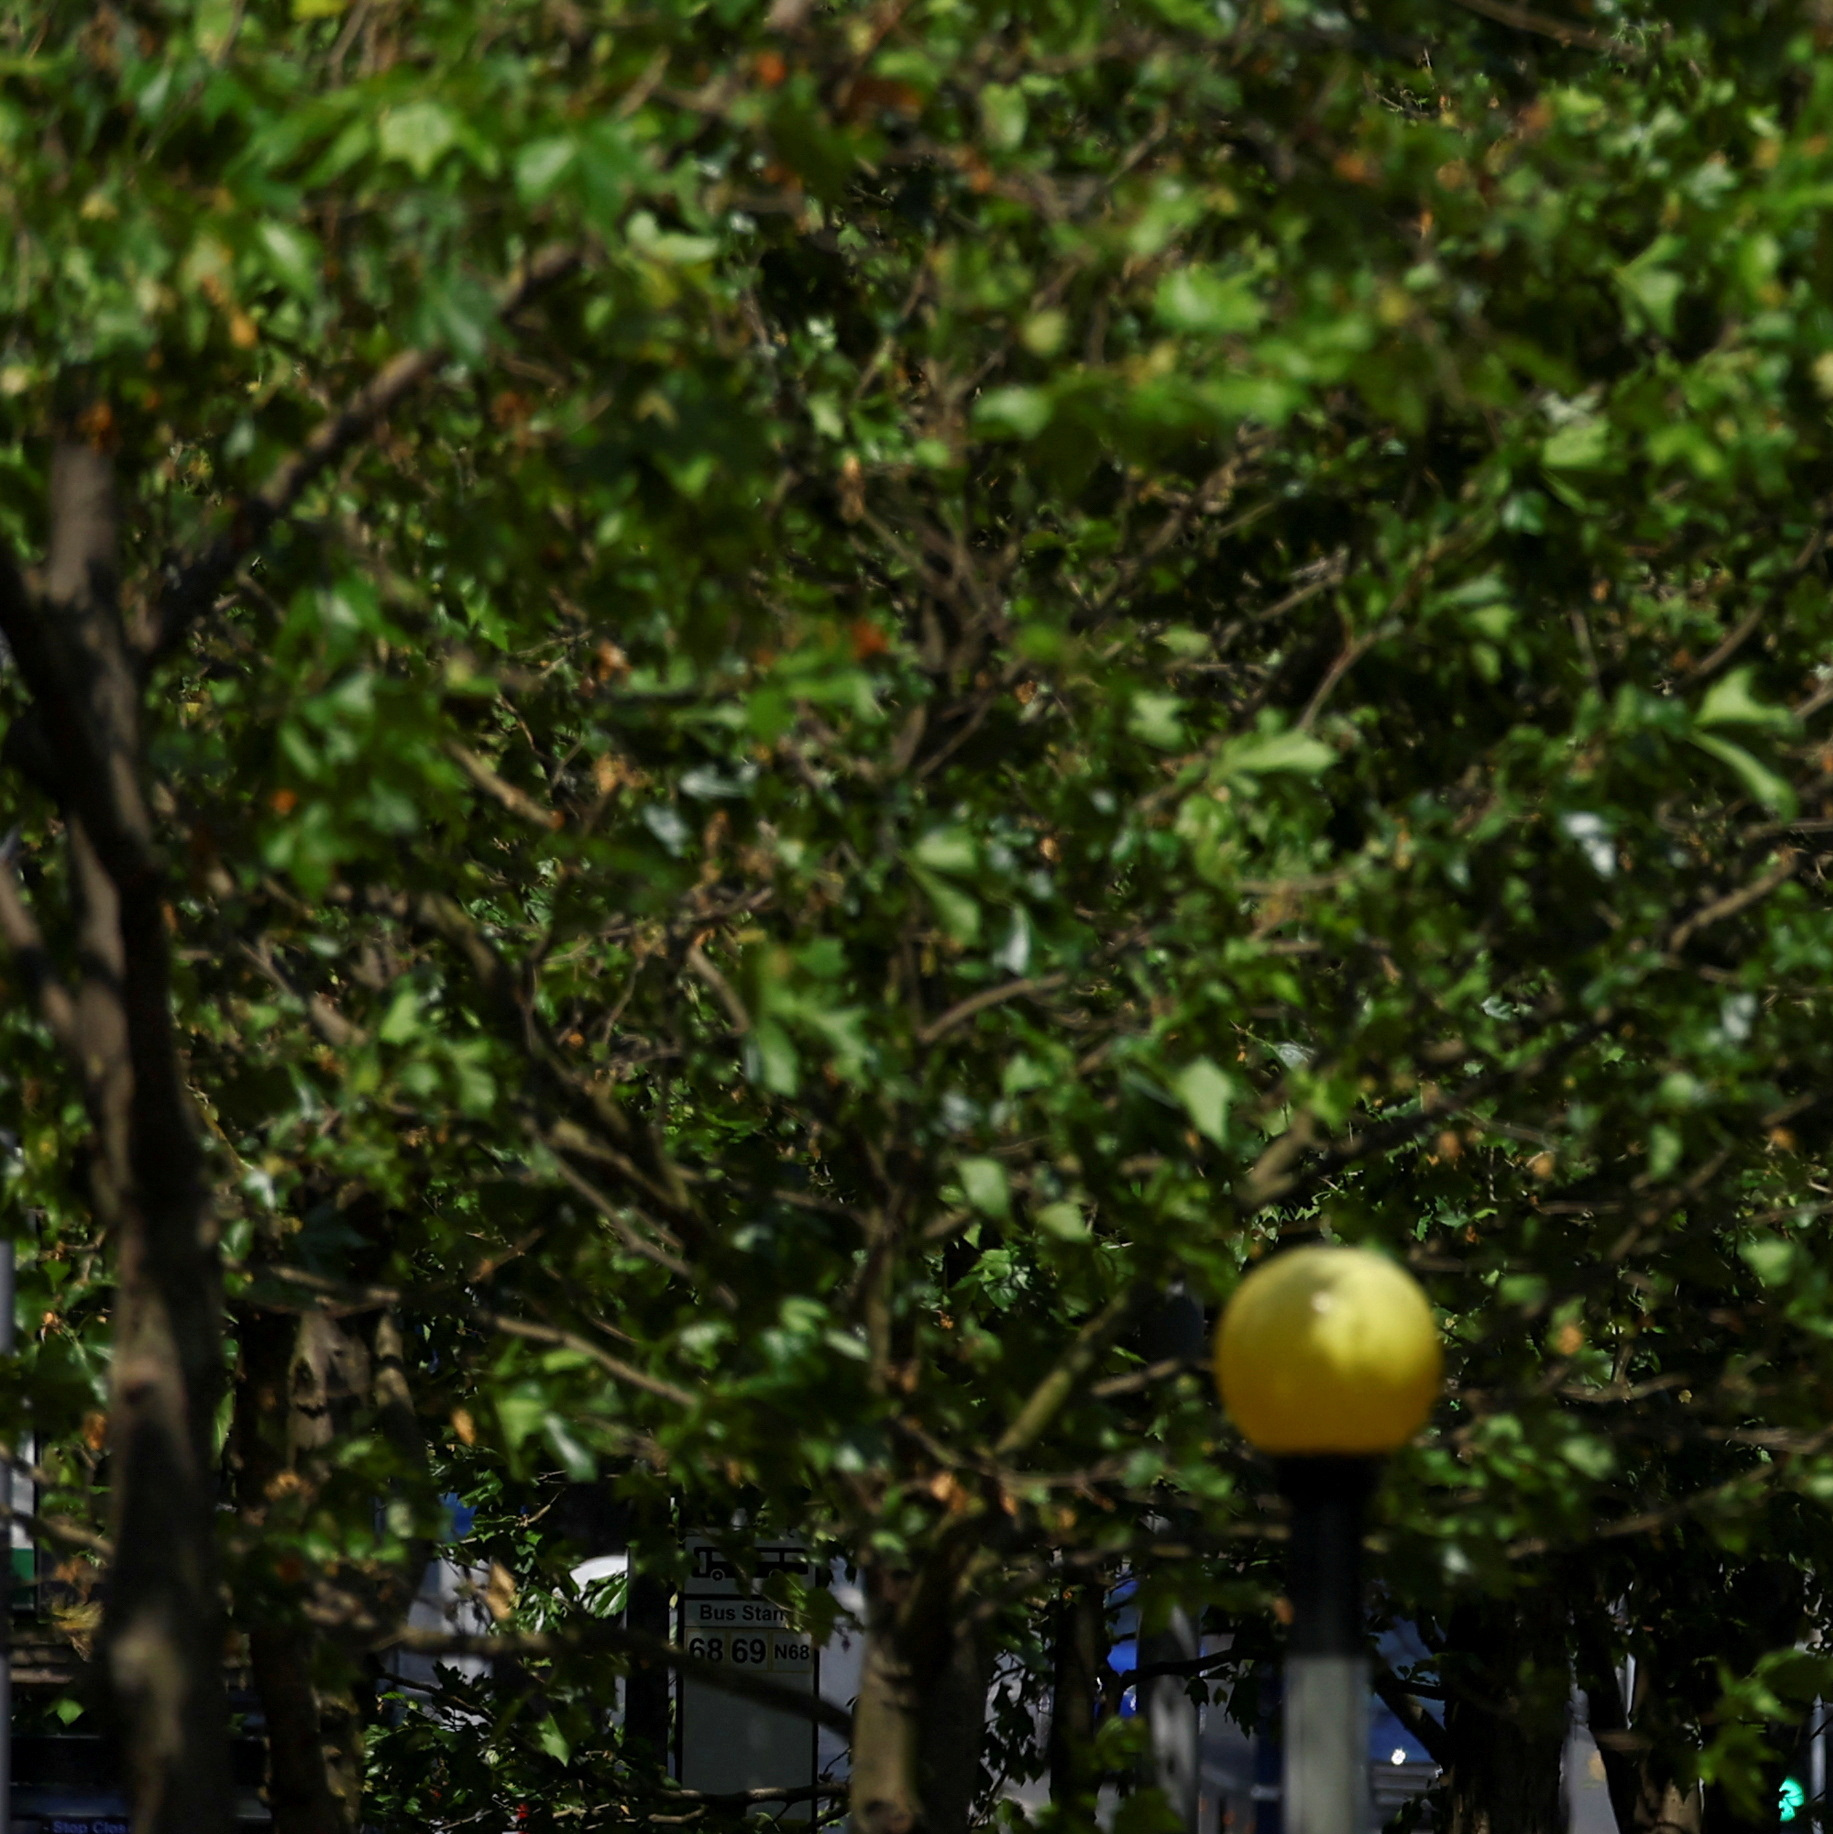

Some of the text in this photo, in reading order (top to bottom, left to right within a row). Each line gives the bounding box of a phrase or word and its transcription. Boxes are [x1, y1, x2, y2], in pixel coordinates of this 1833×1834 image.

[700, 1604, 784, 1622] Bus Stan
[689, 1638, 810, 1664] 68 69 N68
